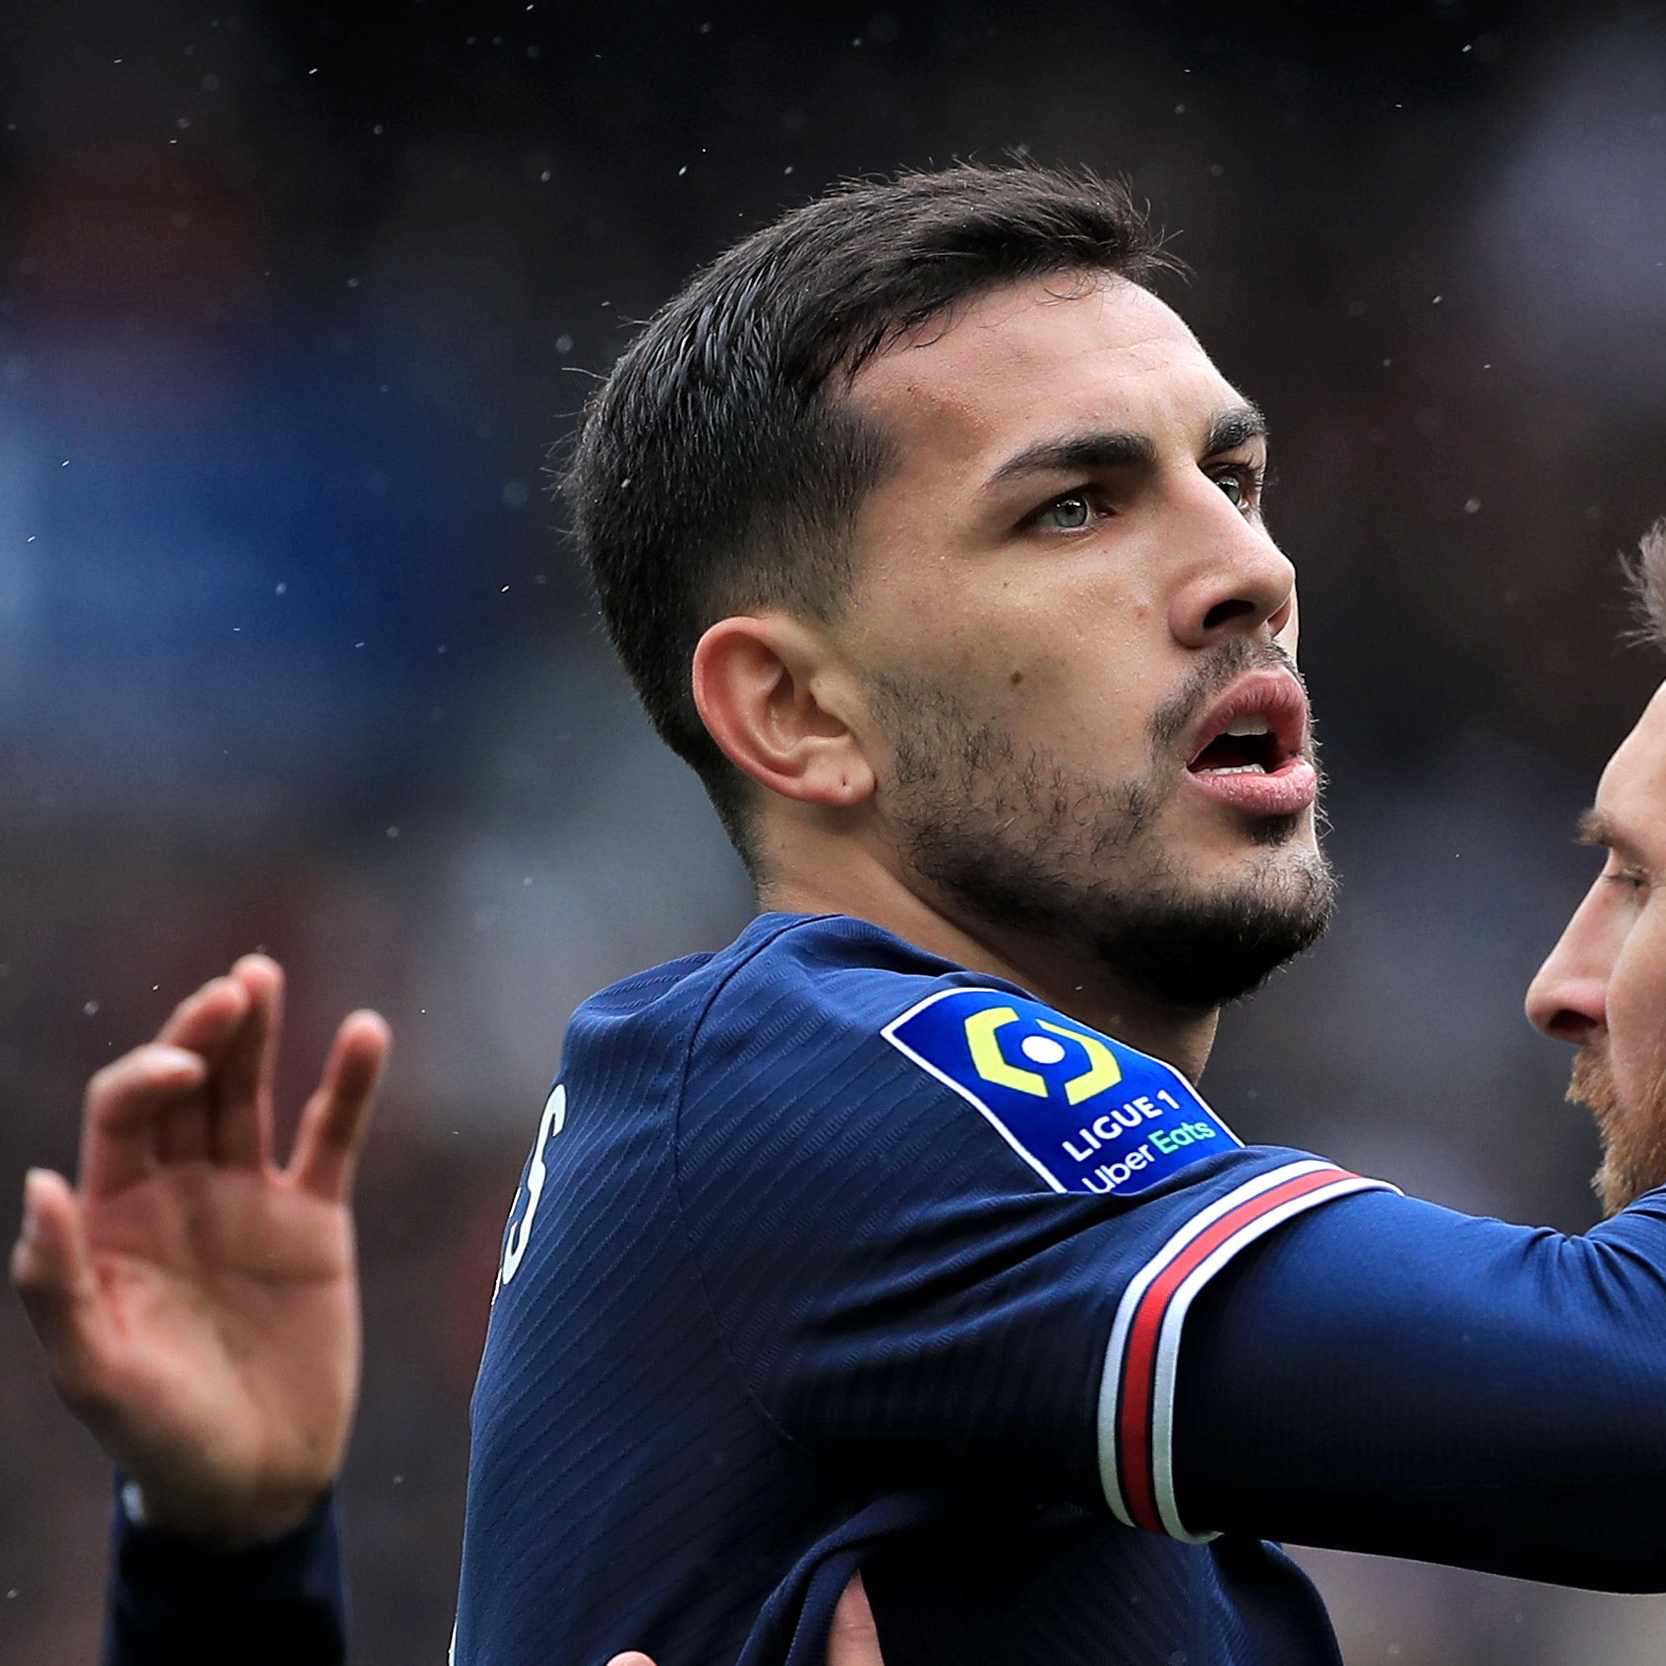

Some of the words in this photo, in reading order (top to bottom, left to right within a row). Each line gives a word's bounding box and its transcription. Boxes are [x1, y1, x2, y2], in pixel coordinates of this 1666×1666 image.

[1061, 1096, 1163, 1162] LIGUE
[1157, 1089, 1180, 1110] 1
[1082, 1144, 1155, 1194] Uber
[1148, 1121, 1217, 1155] Eats
